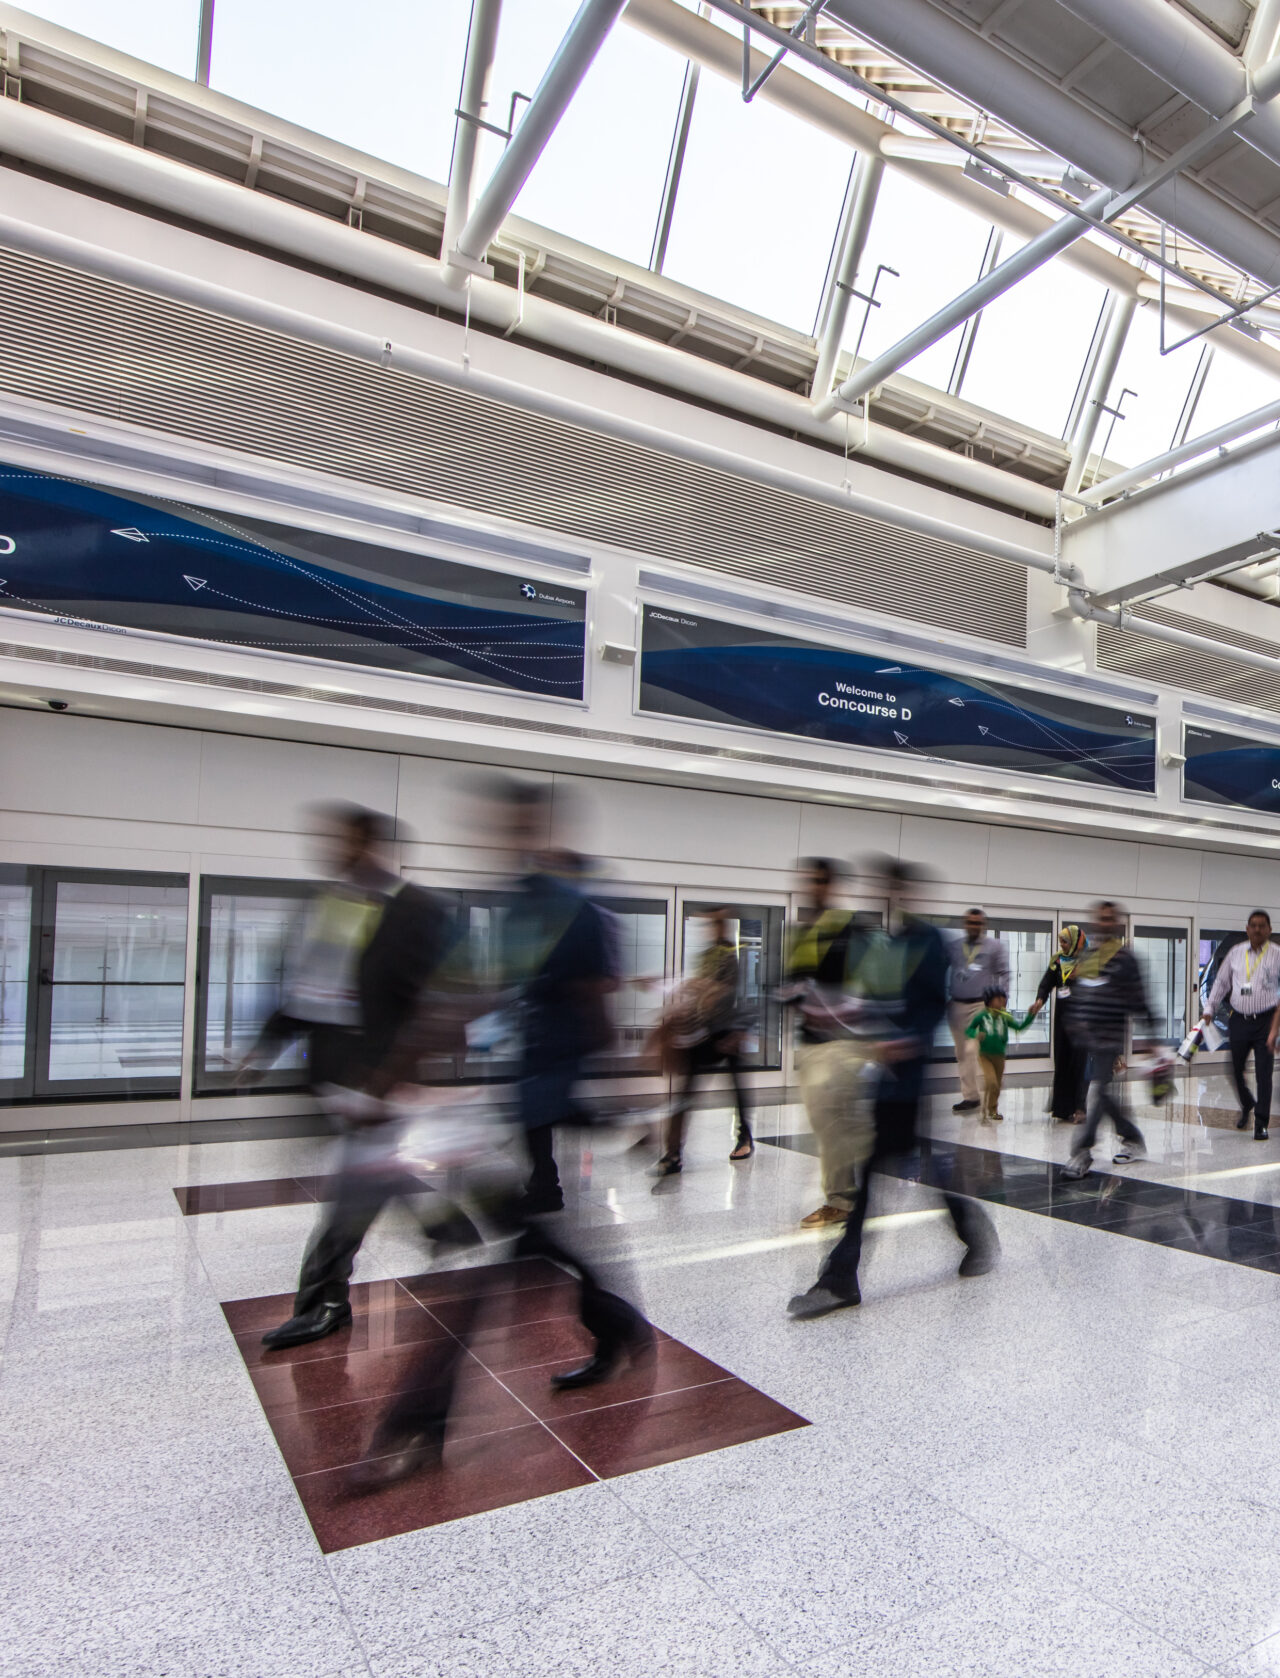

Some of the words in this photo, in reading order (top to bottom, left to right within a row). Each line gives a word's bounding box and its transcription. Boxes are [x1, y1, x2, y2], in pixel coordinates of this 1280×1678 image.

[538, 593, 555, 601] Dubai
[555, 596, 576, 605] Airports
[649, 612, 680, 623] JCDecaux
[835, 681, 883, 700] Welcome
[886, 692, 897, 703] to
[818, 692, 898, 719] Concourse
[901, 707, 912, 721] D
